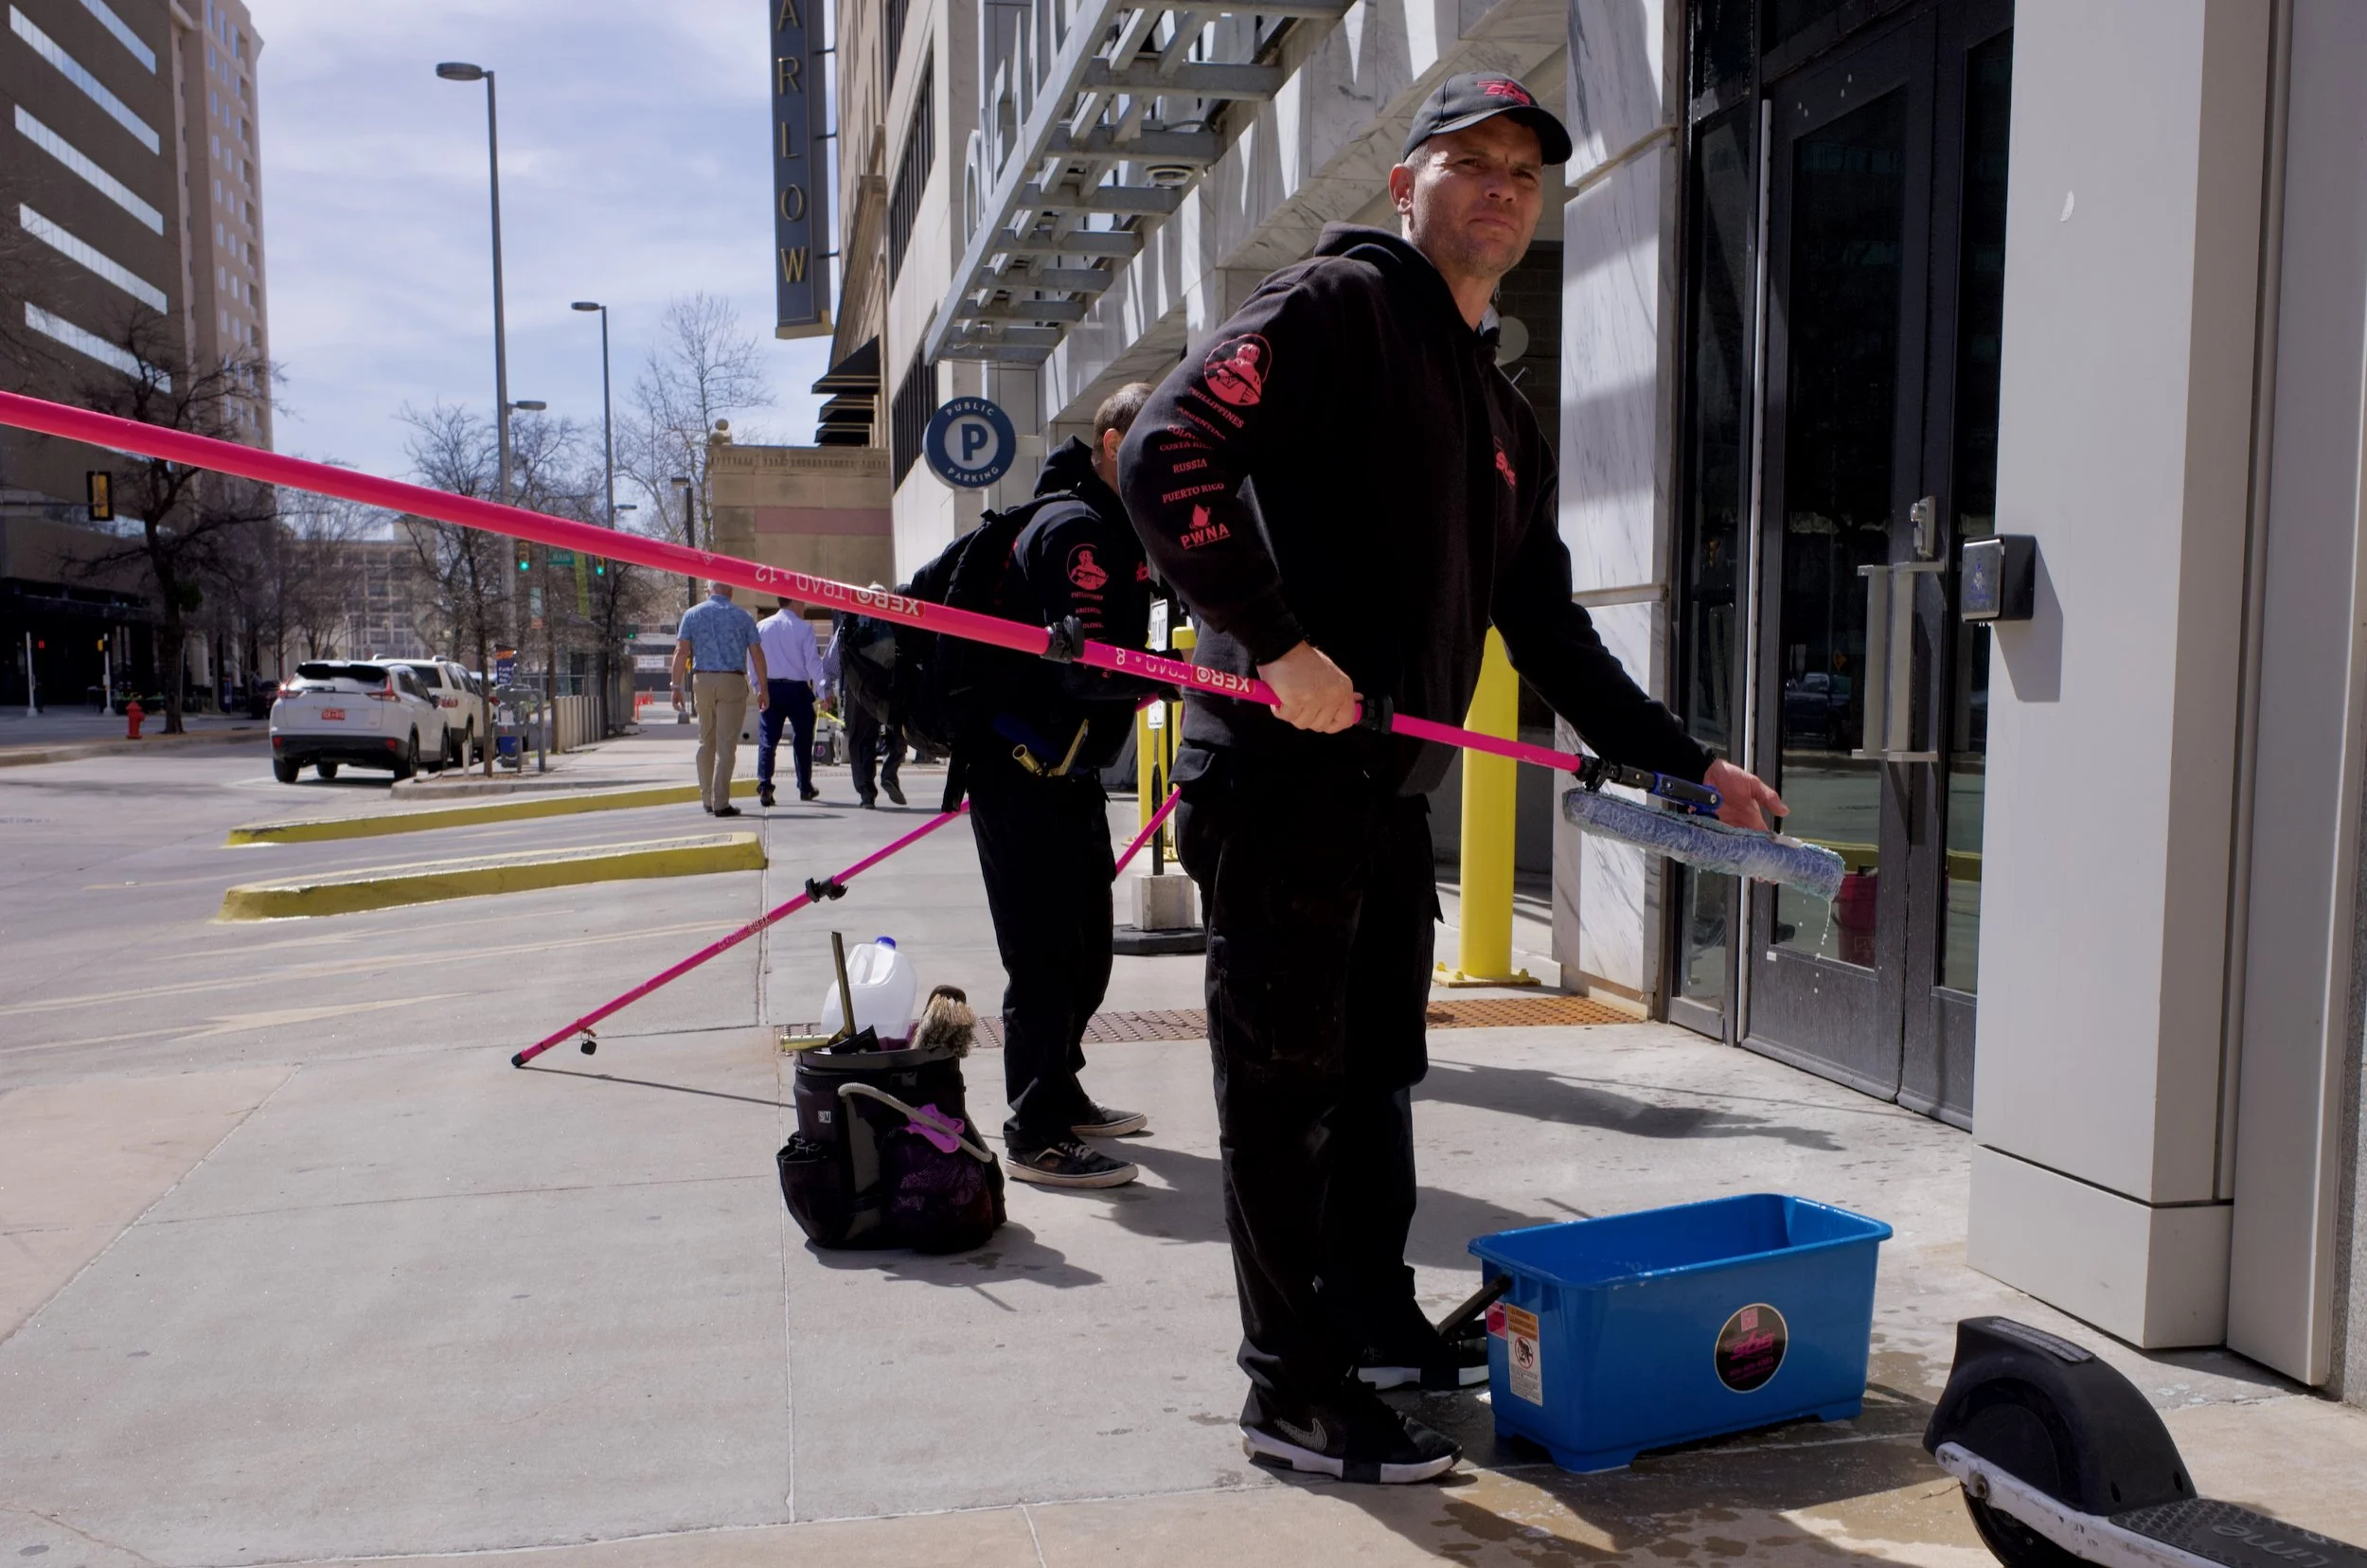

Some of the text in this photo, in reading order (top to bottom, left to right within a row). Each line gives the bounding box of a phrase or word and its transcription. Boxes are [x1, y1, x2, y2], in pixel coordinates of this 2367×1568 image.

[946, 401, 995, 417] PUBLIC
[1177, 405, 1226, 440] ARGENTIN
[962, 423, 988, 461] P
[1159, 440, 1213, 452] COSTA RIC
[948, 466, 999, 482] PARKING
[1173, 458, 1207, 473] RUSSIA
[1163, 482, 1225, 504] PUERTO RICO
[1180, 523, 1230, 548] PWNA
[756, 565, 919, 615] XERO TRAD 12
[1115, 648, 1127, 665] 8
[1196, 666, 1250, 693] XERO
